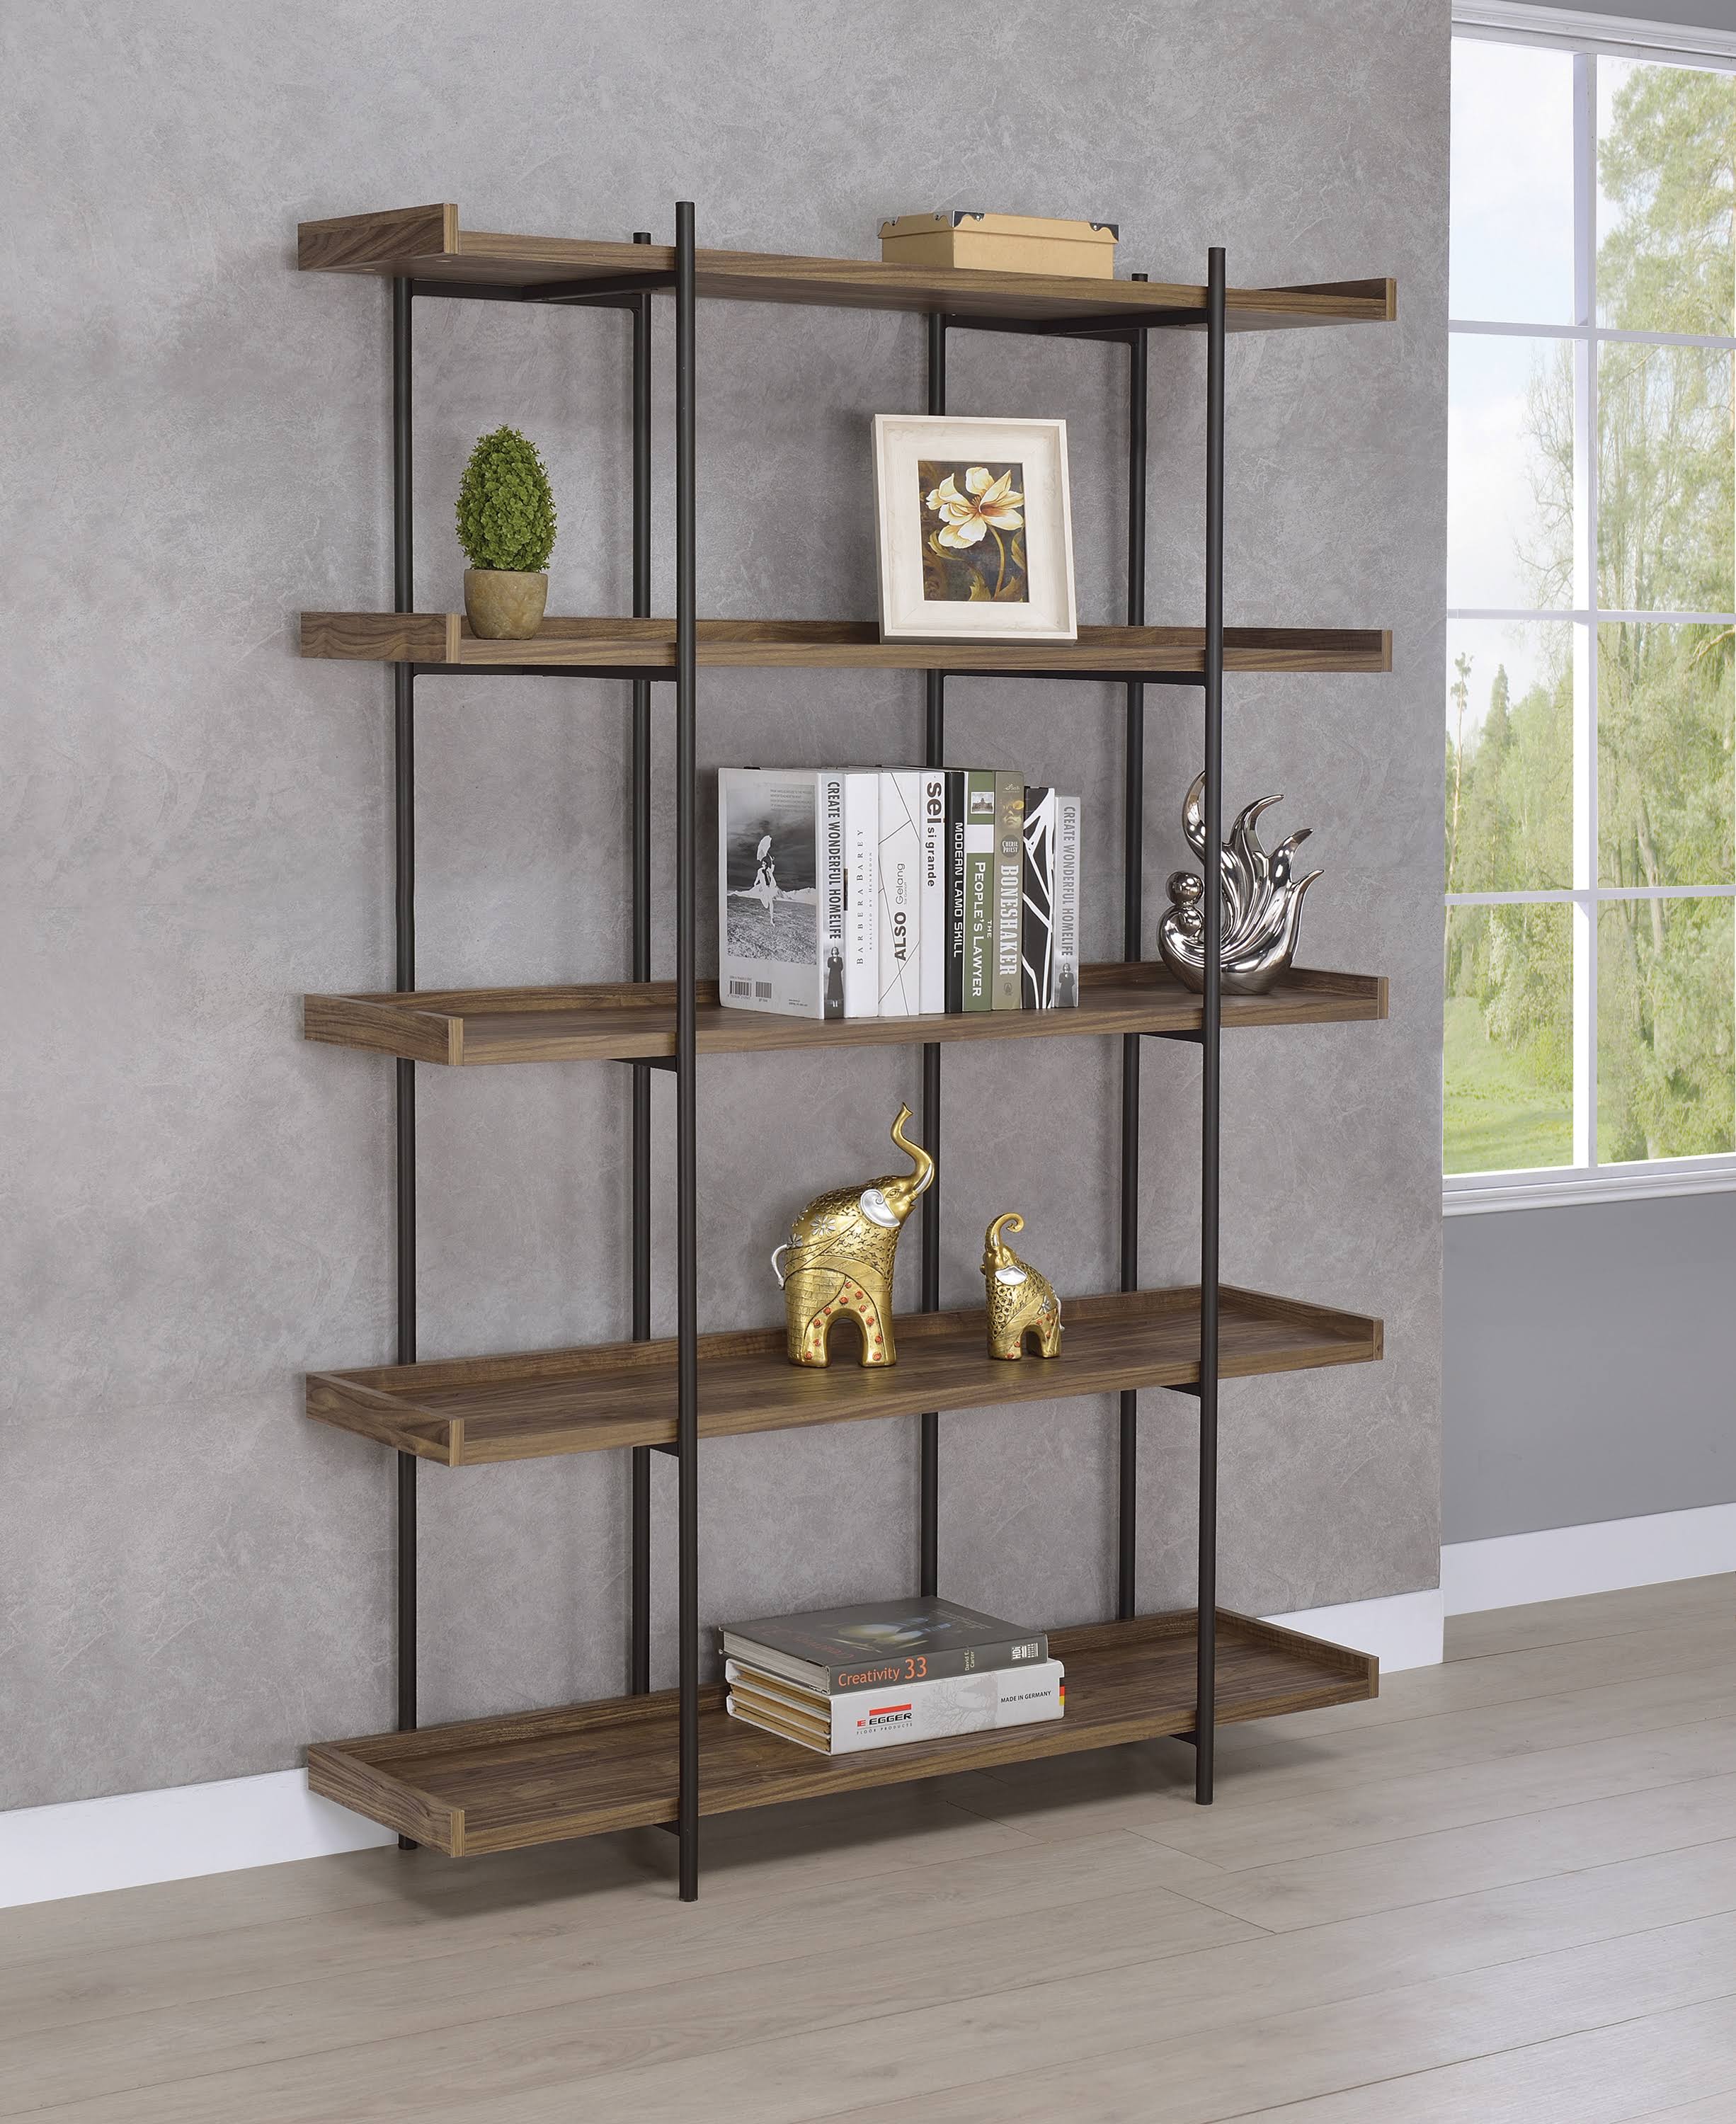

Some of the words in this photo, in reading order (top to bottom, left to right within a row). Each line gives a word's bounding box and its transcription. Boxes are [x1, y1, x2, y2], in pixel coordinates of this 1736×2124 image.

[827, 782, 840, 818] CREATE
[927, 827, 937, 838] si
[1063, 806, 1076, 840] CREATE
[828, 821, 840, 885] WONDERFUL
[925, 842, 937, 886] grande
[954, 823, 964, 875] MODERN
[896, 863, 906, 905] Gelang
[1062, 845, 1075, 904] WONDERFUL
[828, 889, 841, 939] HOMELIFE
[954, 881, 963, 917] LAMO
[973, 862, 986, 932] PEOPLE'S
[894, 912, 906, 961] ALSO
[954, 922, 963, 957] SKILL
[1000, 865, 1019, 975] BONESHAKER
[1061, 908, 1074, 956] HOMELIFE
[972, 936, 984, 996] LAWYER
[838, 1667, 900, 1686] Creativity
[905, 1656, 927, 1679] 33
[1024, 1691, 1051, 1699] GERMANY
[869, 1713, 912, 1725] EGGER
[880, 1723, 913, 1731] PRODUCTS
